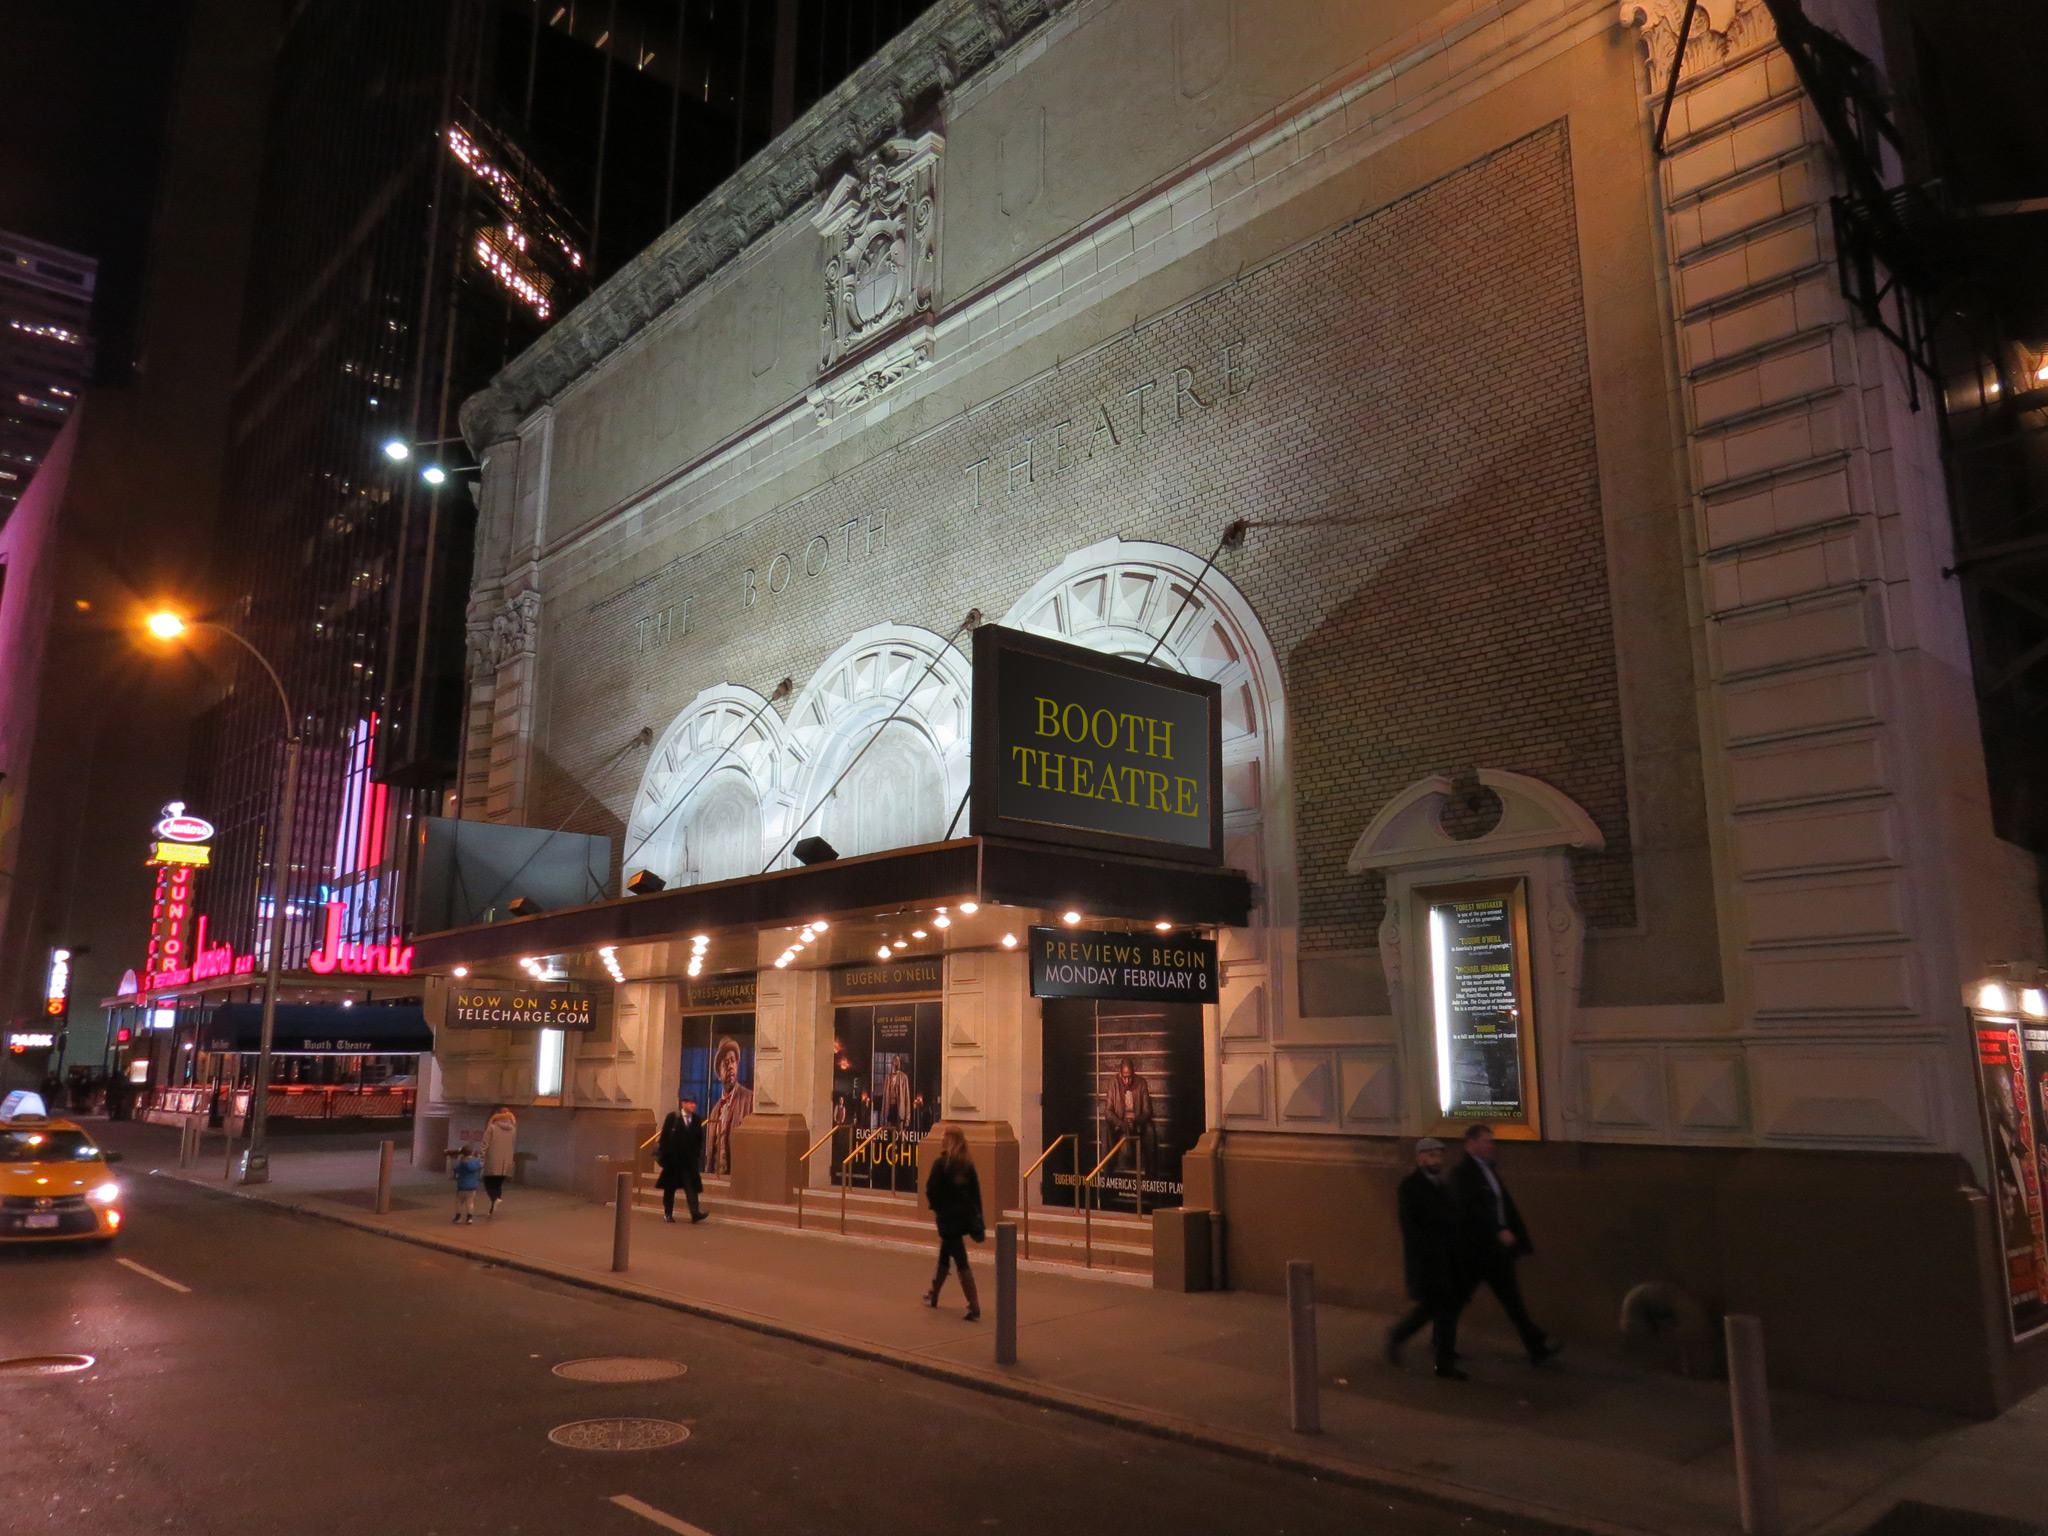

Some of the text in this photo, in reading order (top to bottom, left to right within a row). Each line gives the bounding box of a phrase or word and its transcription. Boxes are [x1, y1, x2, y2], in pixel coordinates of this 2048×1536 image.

[635, 340, 1255, 655] THE BOOTH THEATRE
[1034, 697, 1174, 760] BOOTH
[1011, 745, 1199, 818] THEATRE
[1045, 940, 1206, 970] PREVIEWS BEGIN
[846, 967, 937, 986] EUGENE O'NEILL
[1045, 964, 1208, 991] MONDAY FEBRUARY 8
[457, 995, 590, 1012] NOW ON SALE
[457, 1008, 590, 1025] TELECHARGE.COM
[10, 1033, 53, 1047] PARK
[304, 1039, 372, 1050] Booth Theatre
[1106, 1177, 1137, 1192] AMERICA'S
